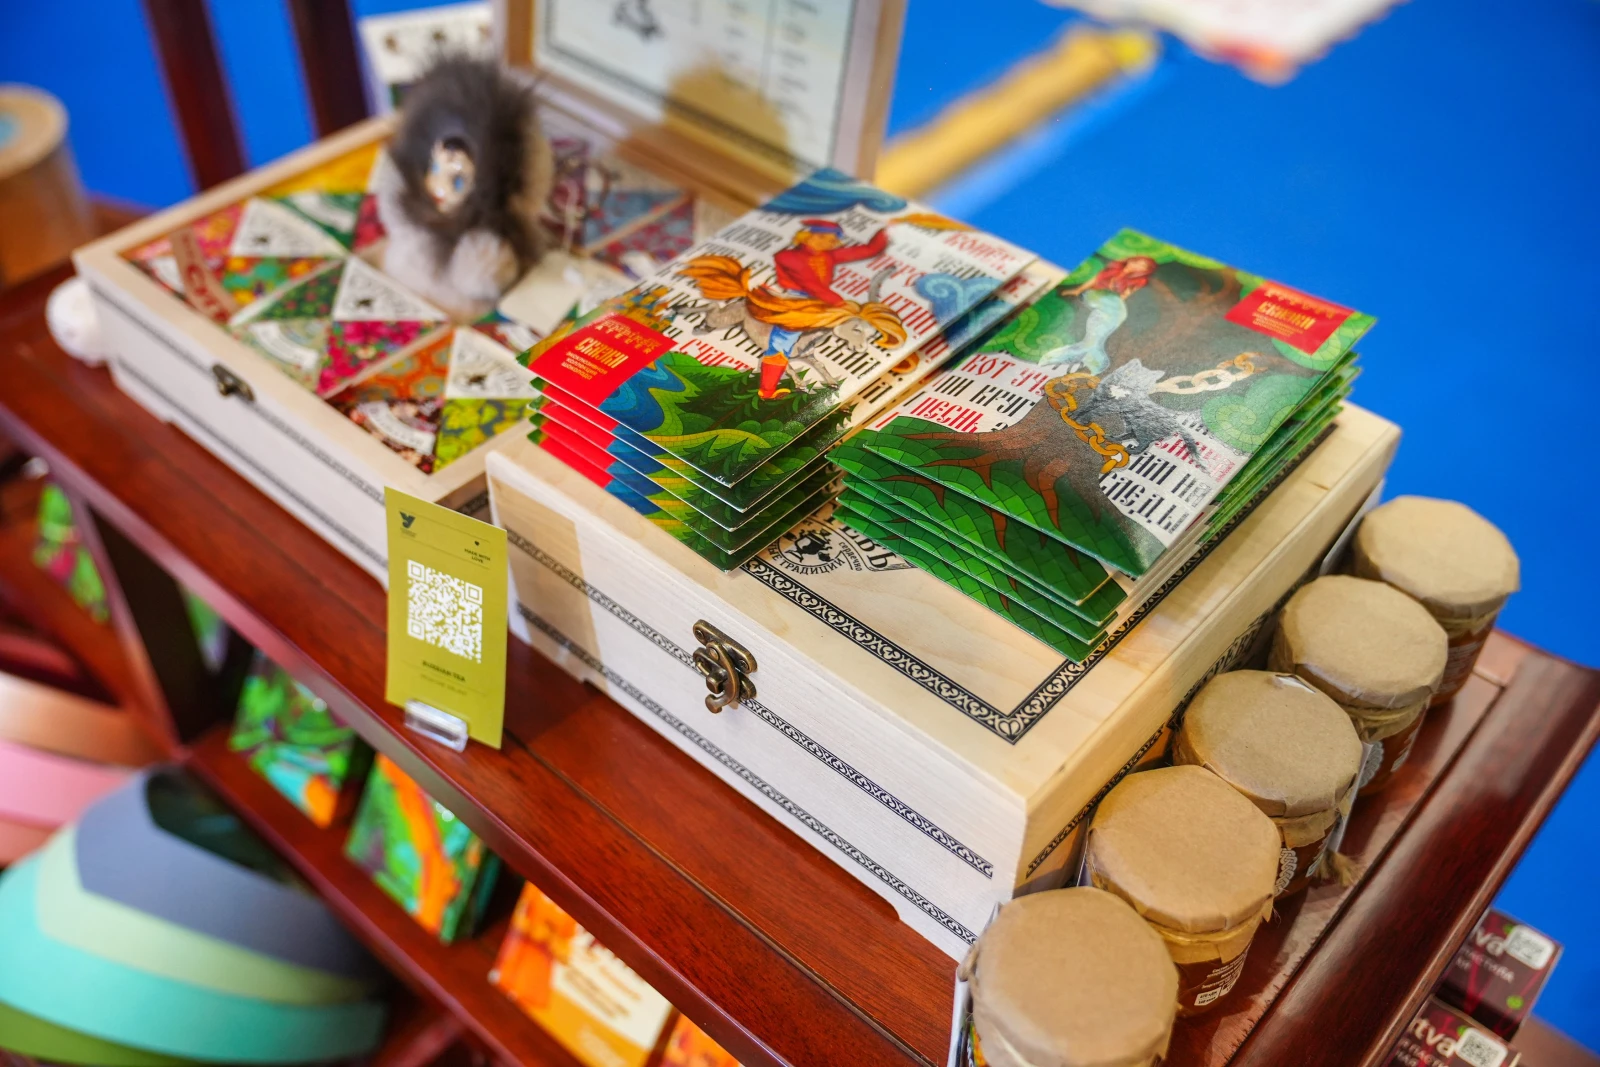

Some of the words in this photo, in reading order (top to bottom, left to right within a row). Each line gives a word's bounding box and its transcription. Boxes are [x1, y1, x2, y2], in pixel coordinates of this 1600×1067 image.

[575, 336, 629, 369] СКАЗКИ
[961, 353, 1016, 380] КОТ
[910, 396, 984, 434] ПЕСНЬ
[780, 554, 847, 576] ТРАДИЦИИ
[837, 540, 864, 572] сердечно
[1474, 926, 1508, 957] va
